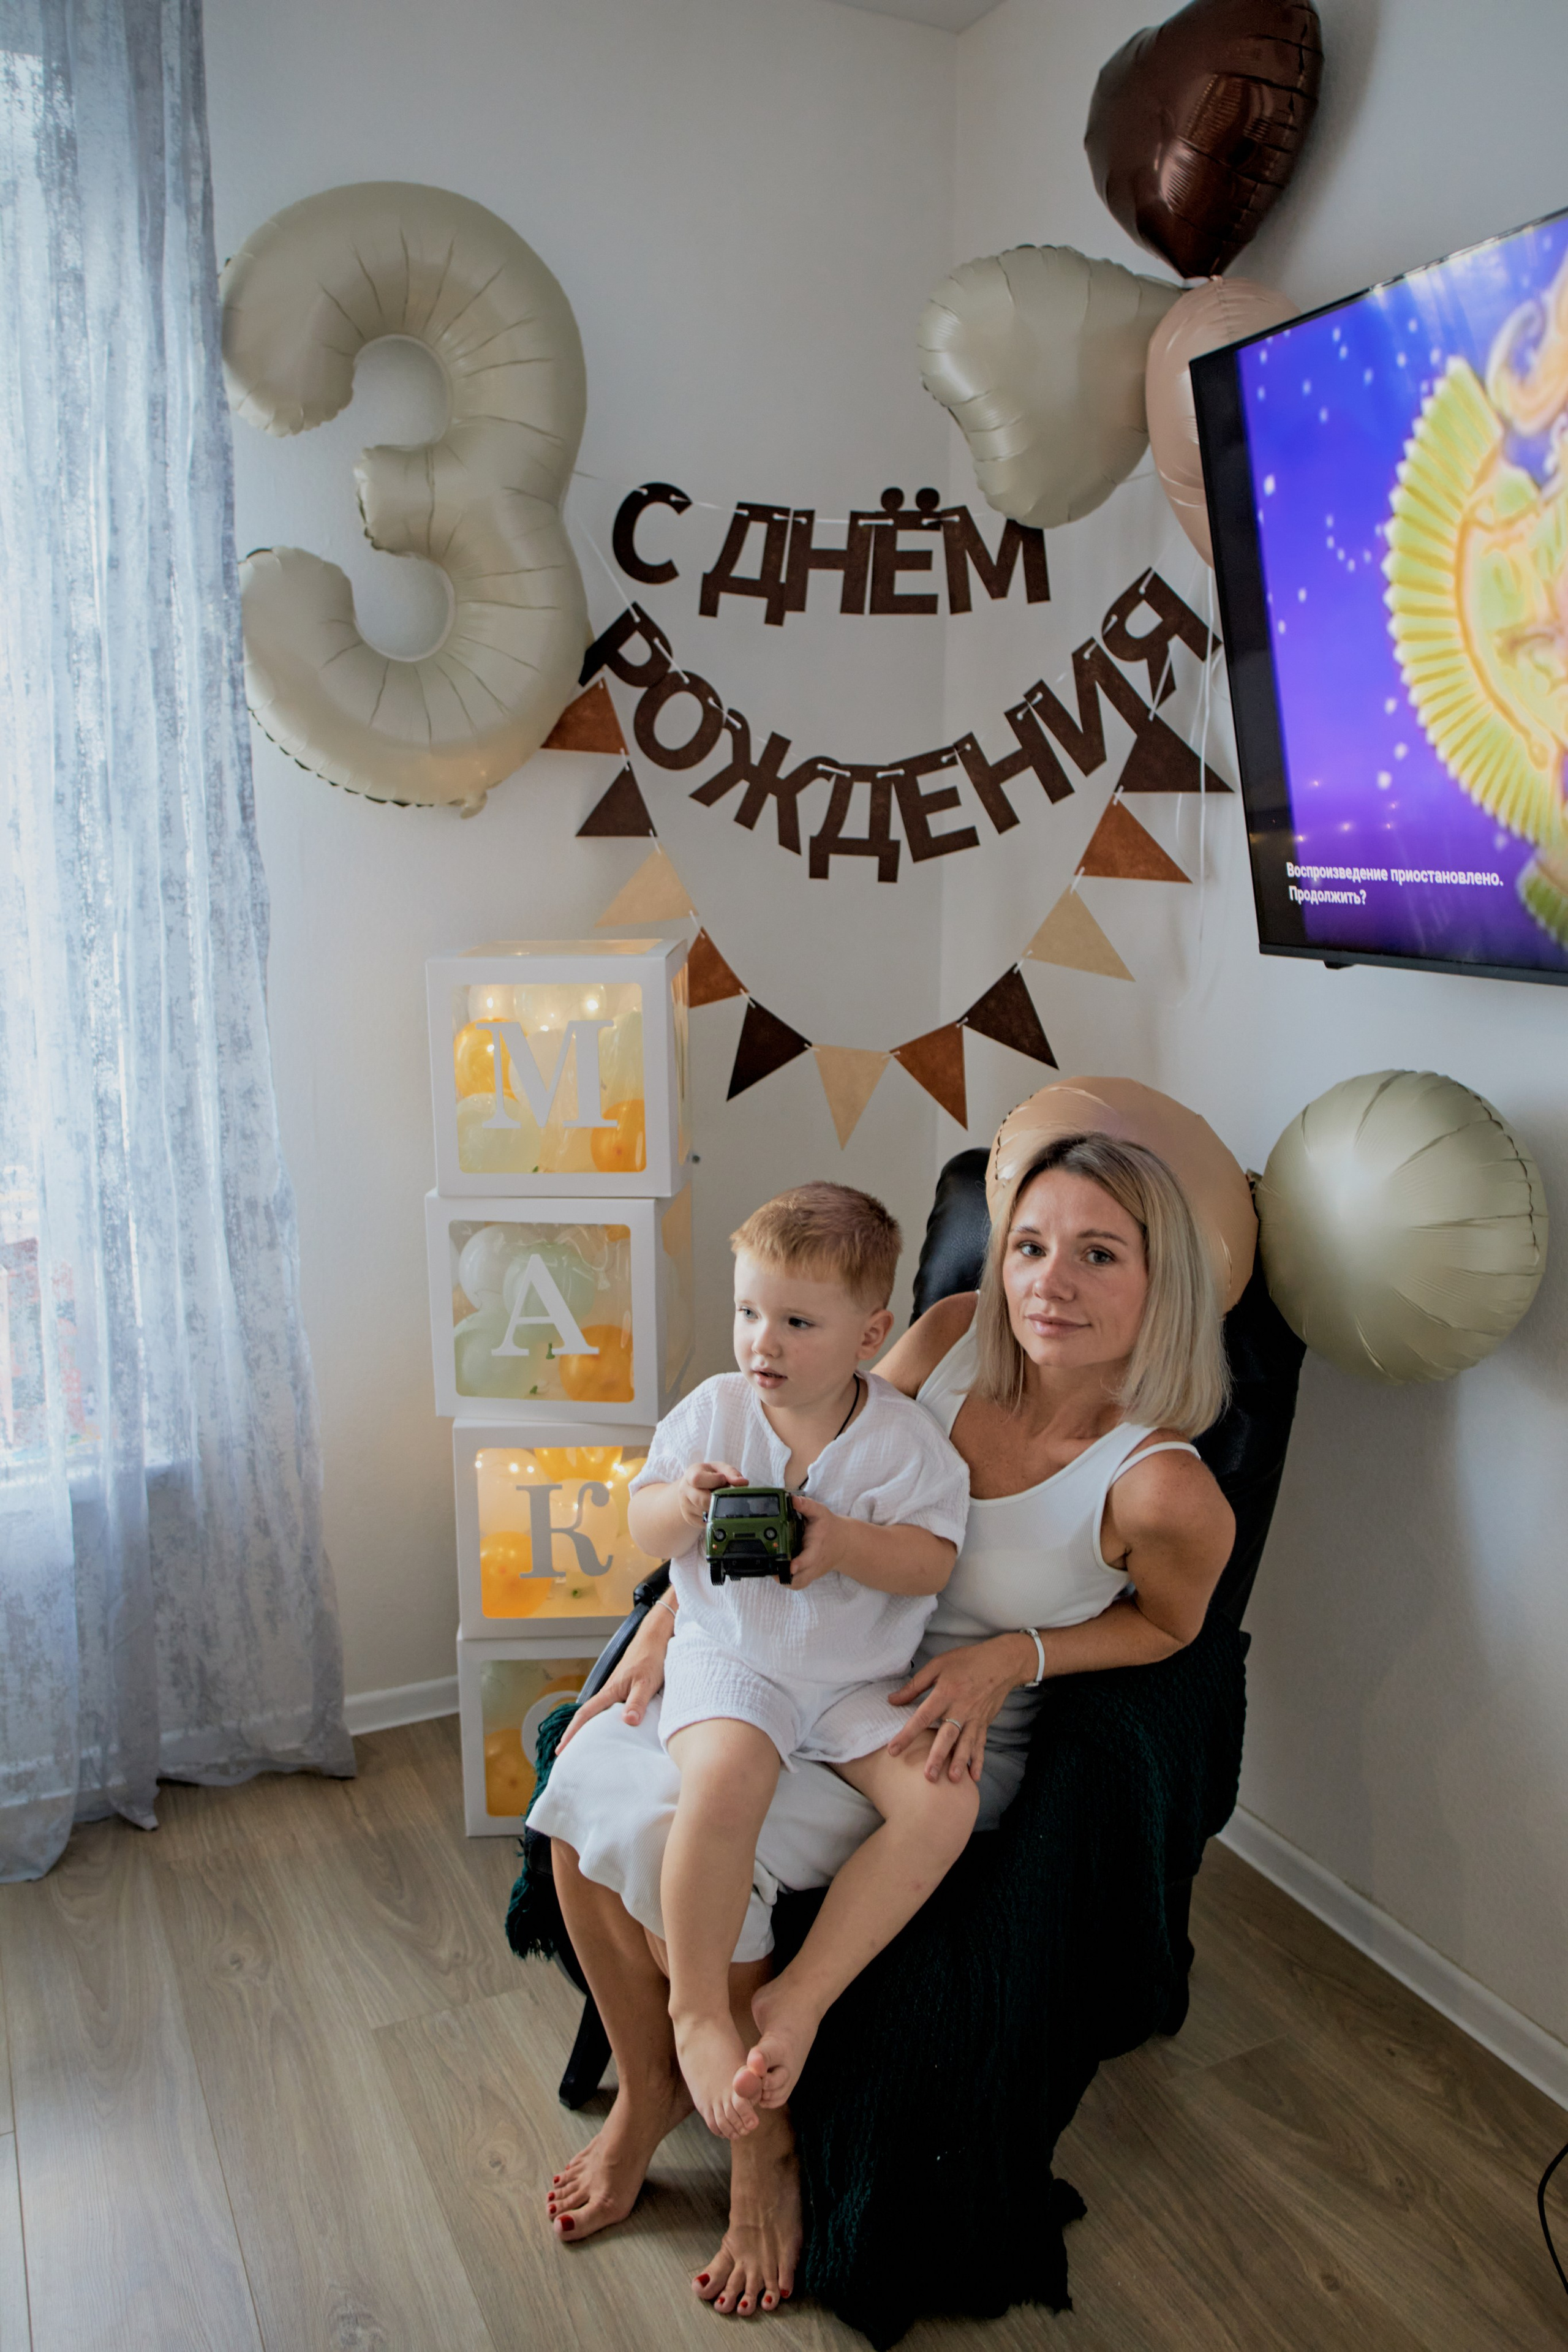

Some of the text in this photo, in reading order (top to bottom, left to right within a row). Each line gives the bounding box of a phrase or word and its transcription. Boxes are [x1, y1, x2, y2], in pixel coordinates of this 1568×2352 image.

[219, 181, 592, 818] 3
[612, 481, 1052, 627] С ДНЁМ
[578, 566, 1224, 883] РОЖДЕНИЯ
[1286, 861, 1504, 886] Воспроизведение приостановлено.
[1288, 885, 1367, 905] Продолжить?
